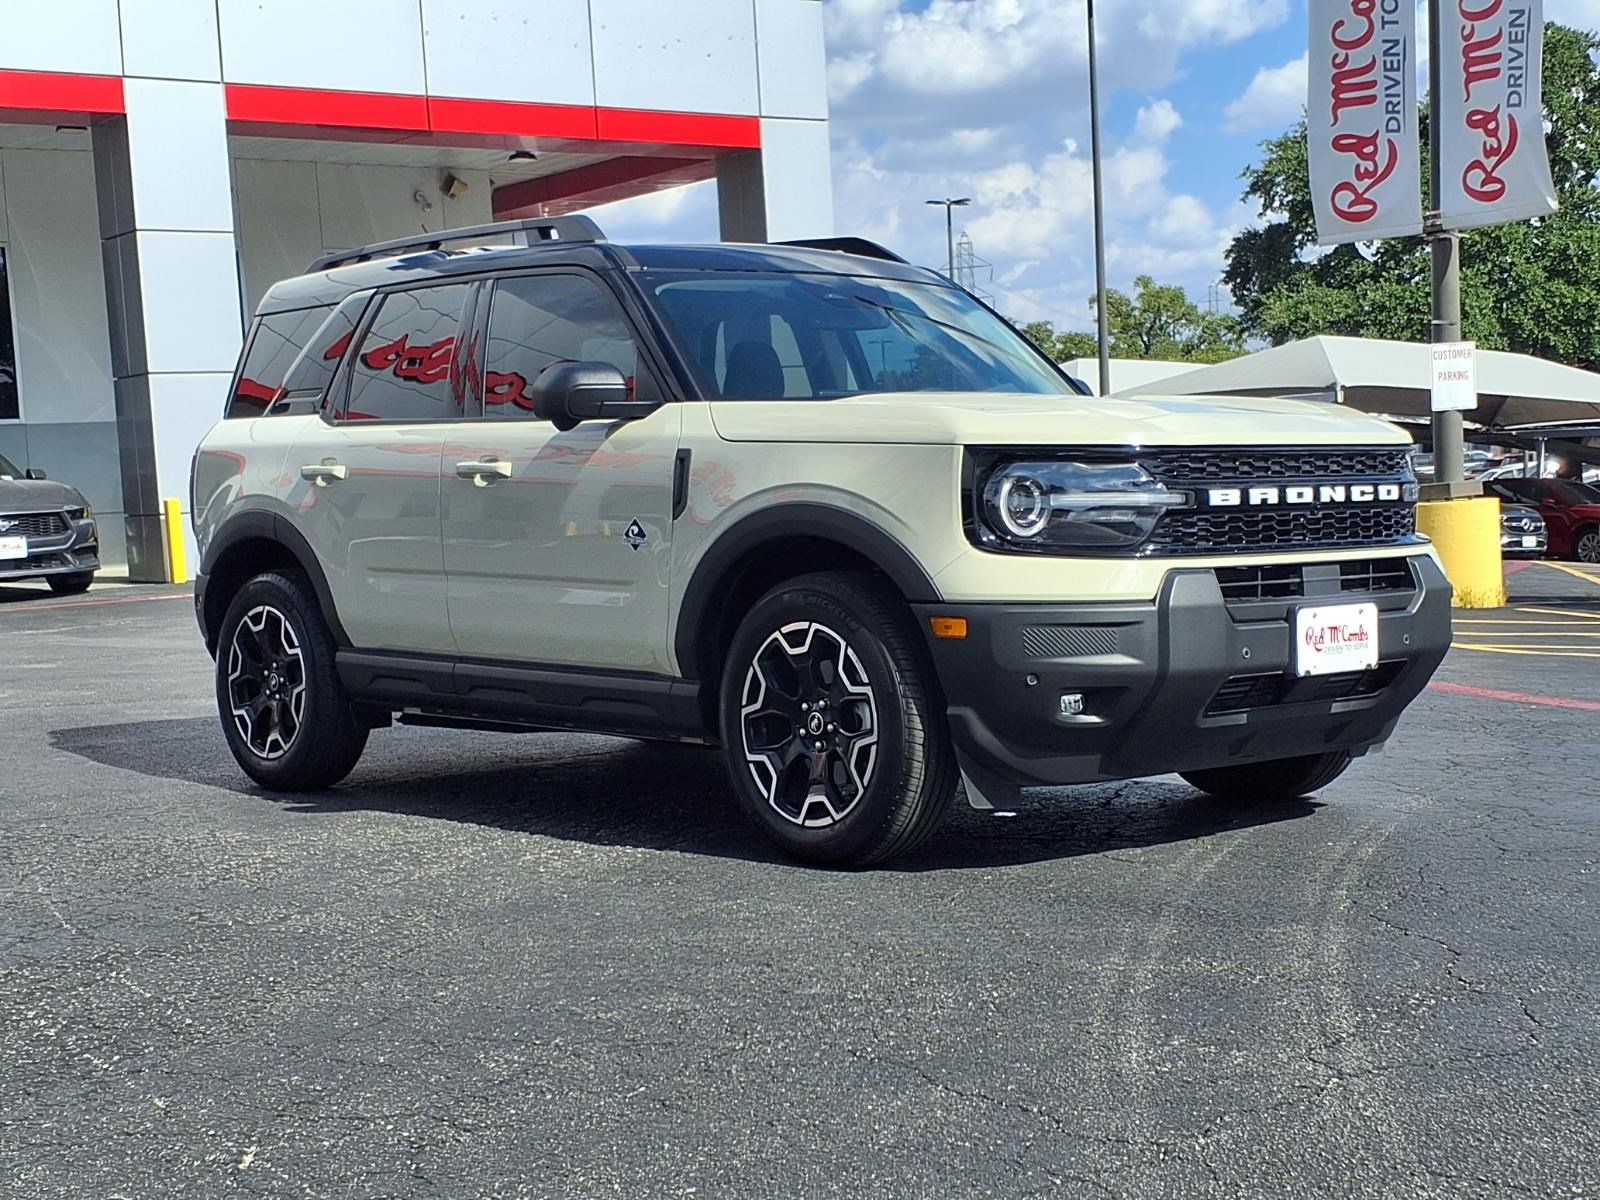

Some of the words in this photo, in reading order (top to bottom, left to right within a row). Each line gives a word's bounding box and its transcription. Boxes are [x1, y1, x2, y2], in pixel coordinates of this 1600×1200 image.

[1381, 0, 1399, 31] TO
[1506, 9, 1526, 108] DRIVEN
[1382, 38, 1401, 134] DRIVEN
[1462, 104, 1519, 203] Red
[1331, 129, 1398, 223] Red
[1433, 349, 1472, 361] CUSTOMER
[1438, 370, 1469, 382] PARKING
[1208, 485, 1400, 506] BRONCO
[1305, 626, 1325, 652] Red
[1327, 624, 1368, 643] McCombs
